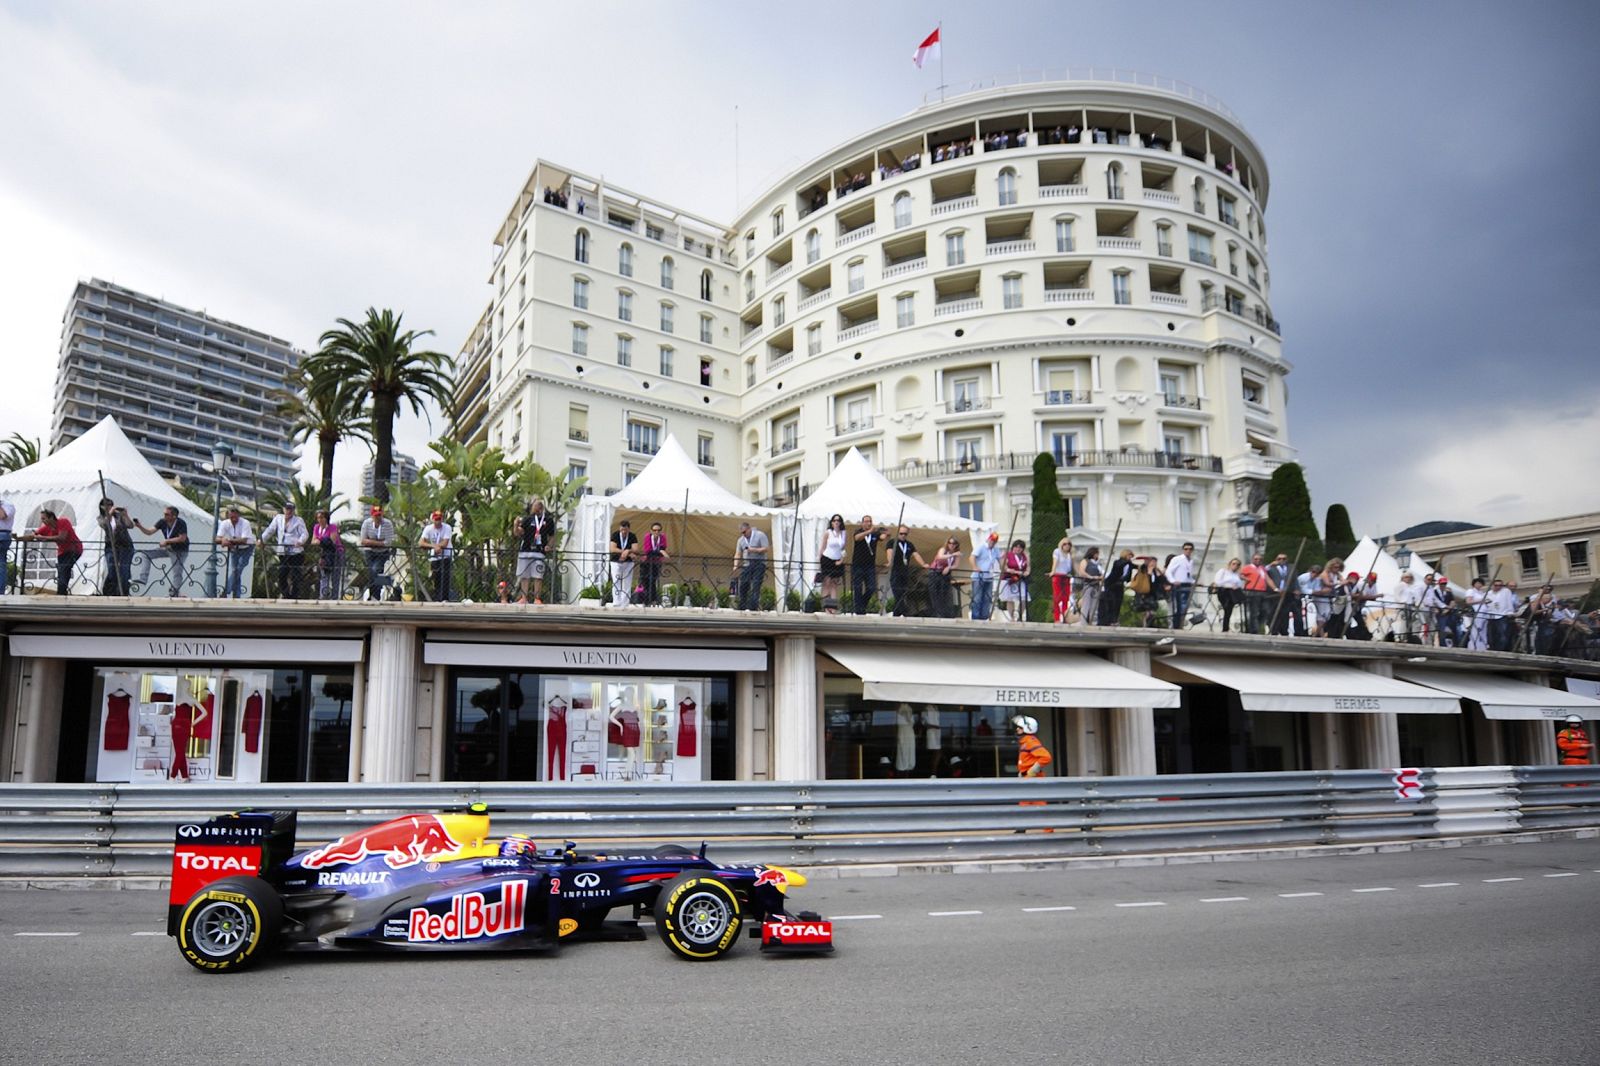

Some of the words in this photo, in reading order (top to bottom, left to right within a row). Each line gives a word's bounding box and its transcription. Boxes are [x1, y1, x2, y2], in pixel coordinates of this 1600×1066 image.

[148, 642, 225, 656] VALENTINO
[562, 651, 637, 665] VALENTINO
[205, 828, 262, 836] INFINITI
[175, 852, 256, 870] TOTAL
[482, 858, 520, 867] GEOX
[318, 871, 391, 886] RENAULT
[550, 878, 561, 894] 2
[563, 889, 611, 898] INFINITI
[666, 879, 697, 915] ZERO
[409, 894, 462, 941] Red
[463, 880, 528, 938] Bull
[768, 923, 831, 936] TOTAL
